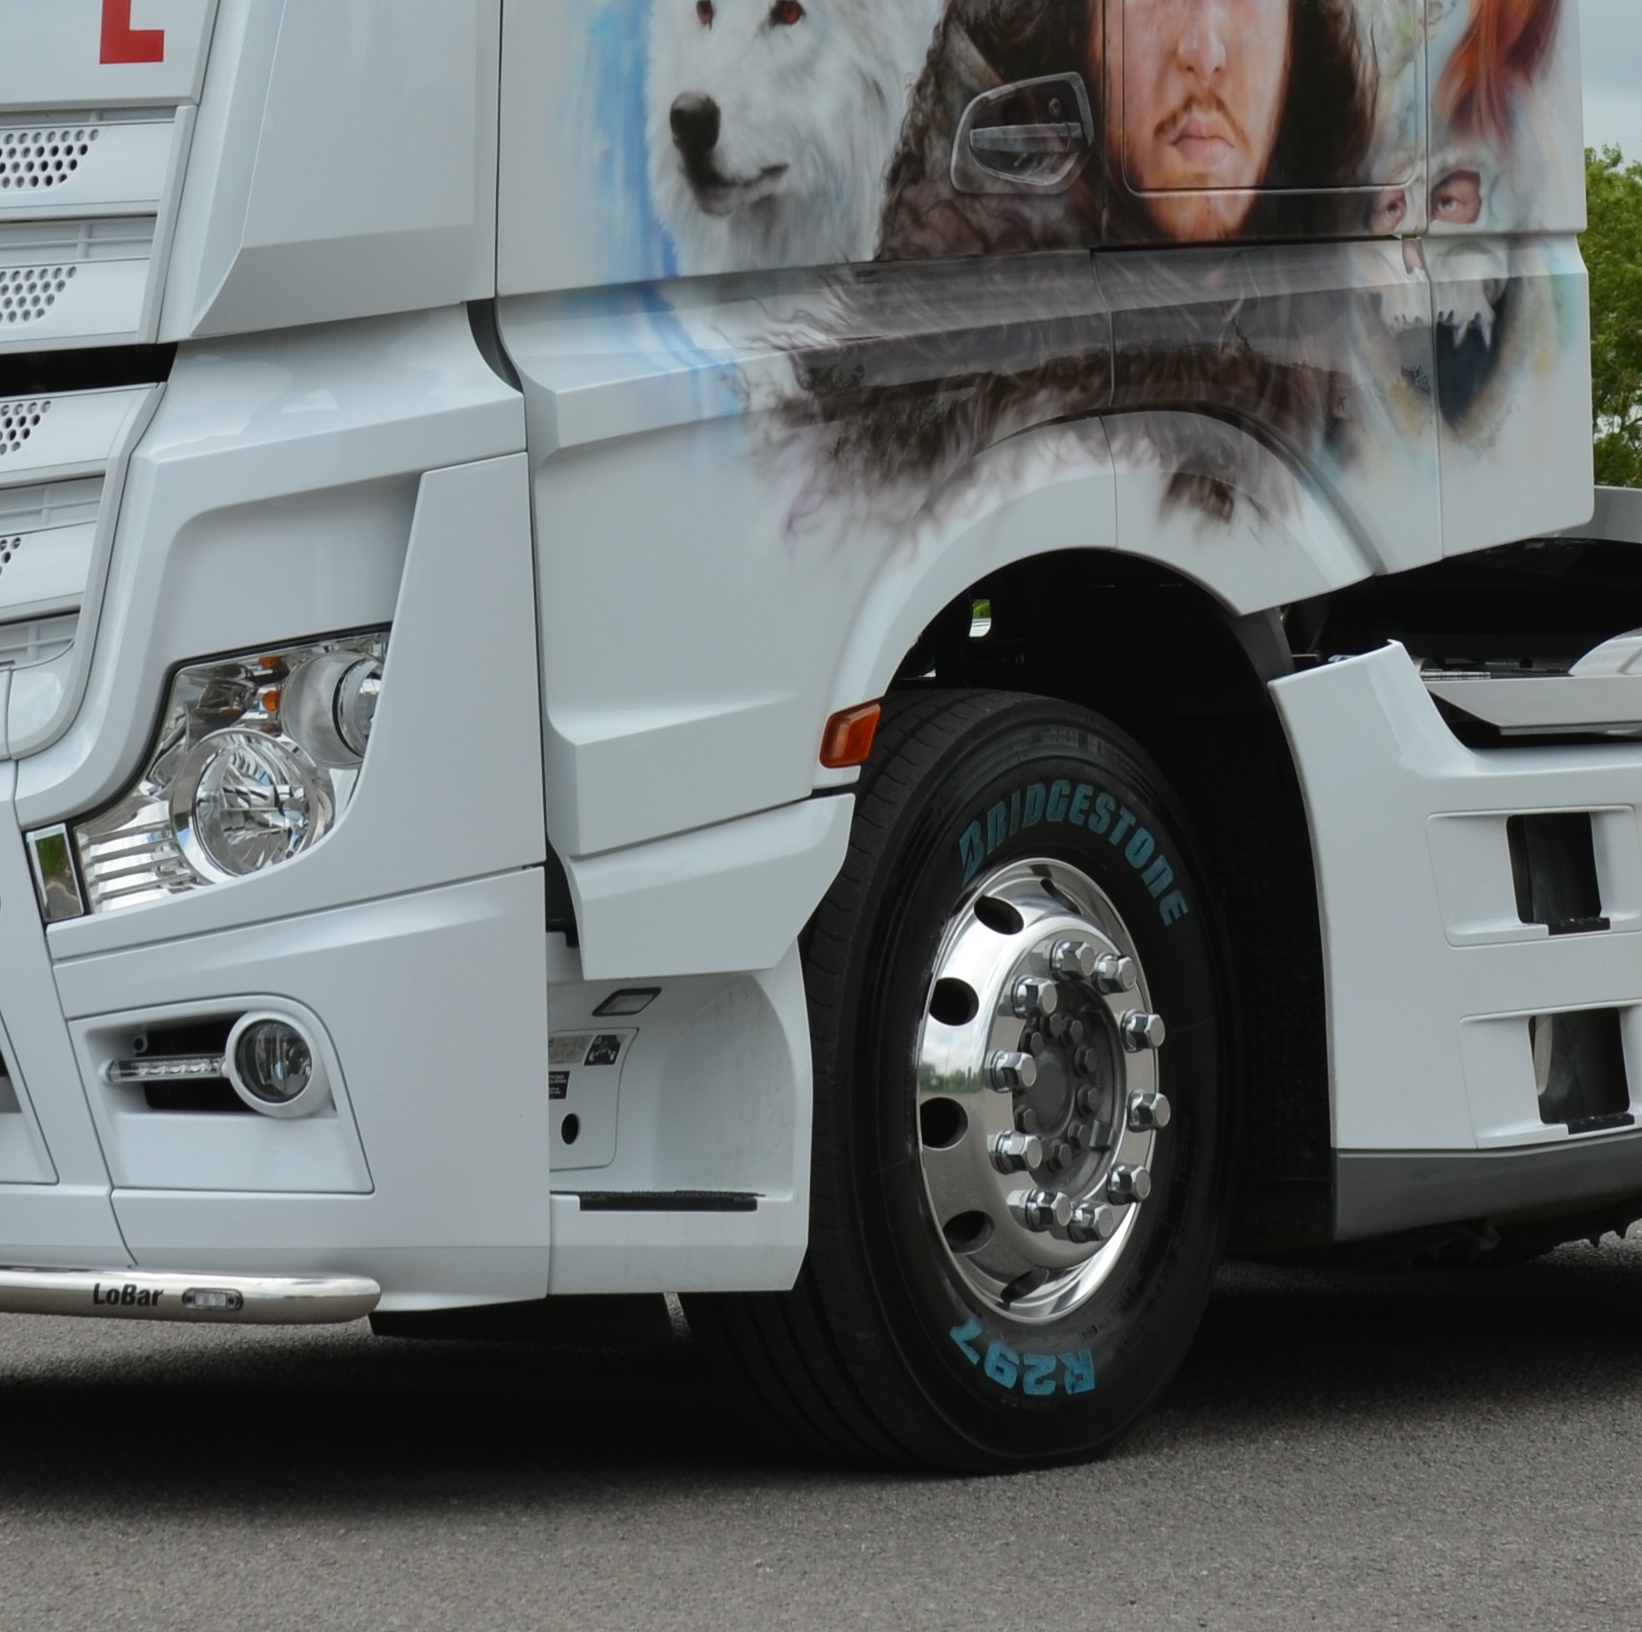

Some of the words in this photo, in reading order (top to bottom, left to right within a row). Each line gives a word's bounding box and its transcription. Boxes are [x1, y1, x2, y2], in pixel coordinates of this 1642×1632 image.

[959, 779, 1189, 926] BRIDGESTONE
[93, 1282, 164, 1307] LoBar
[949, 1319, 1096, 1396] R297
